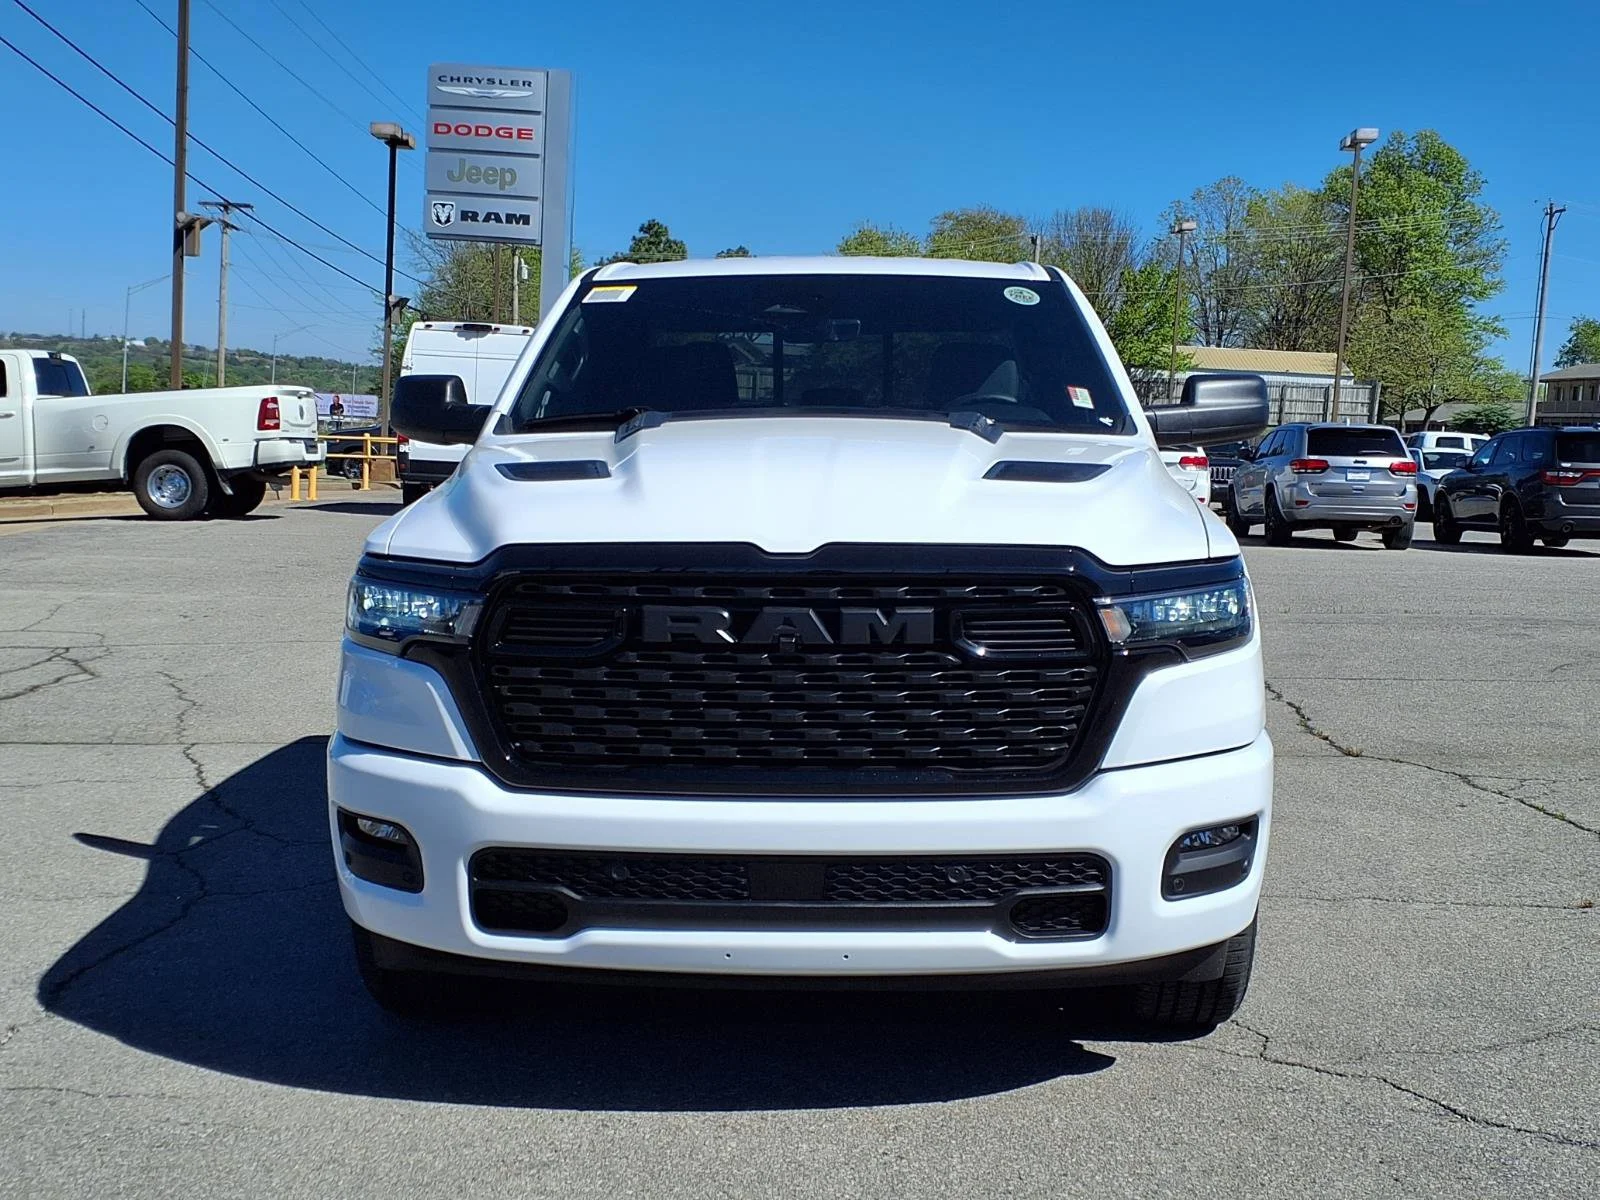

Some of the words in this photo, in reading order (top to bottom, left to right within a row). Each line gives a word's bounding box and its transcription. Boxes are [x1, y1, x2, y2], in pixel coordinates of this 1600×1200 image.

[438, 75, 532, 87] CHRYSLER
[433, 123, 533, 140] DODGE
[447, 158, 517, 190] Jeep
[460, 210, 531, 226] RAM
[642, 605, 936, 644] RAM
